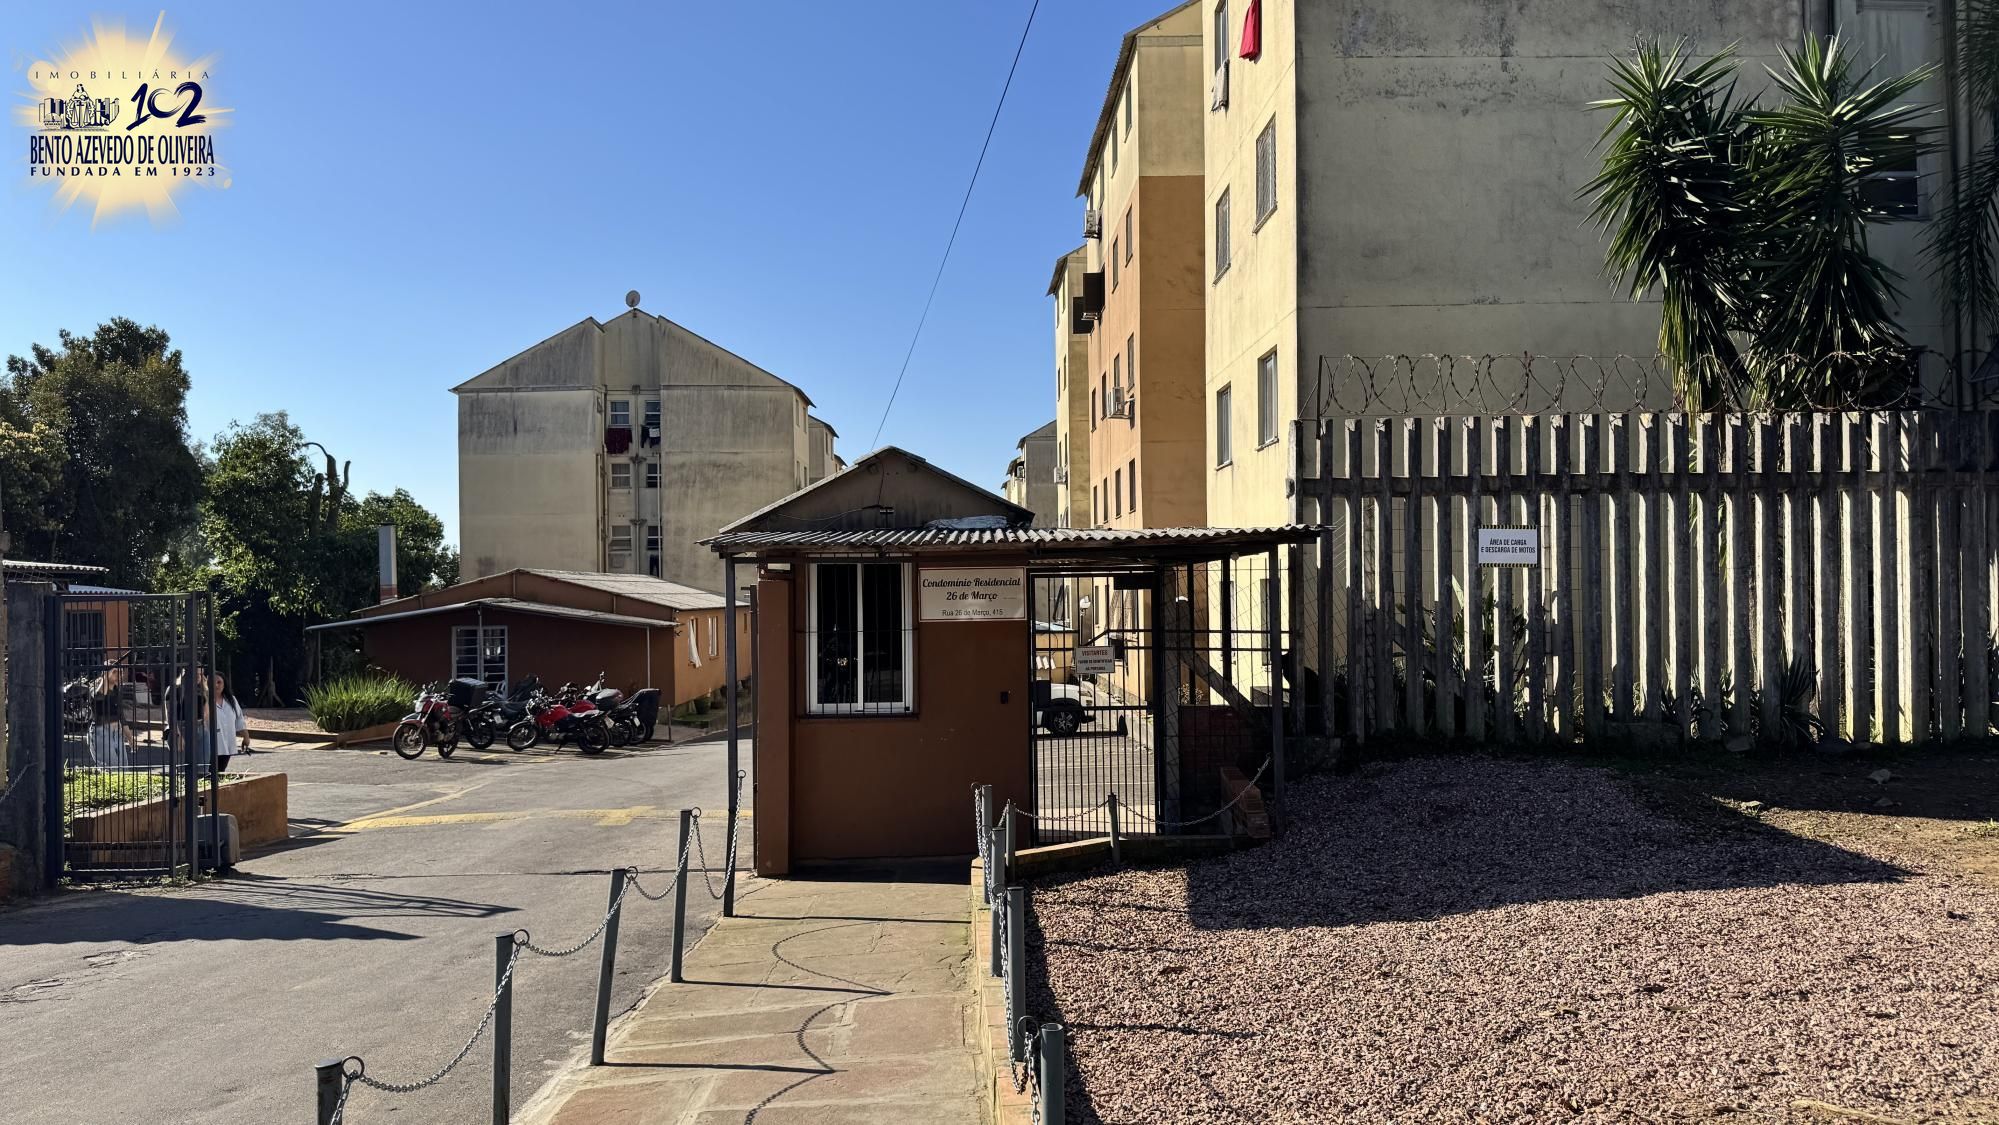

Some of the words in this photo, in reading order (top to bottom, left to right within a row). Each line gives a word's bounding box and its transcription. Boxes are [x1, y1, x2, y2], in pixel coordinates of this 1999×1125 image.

[1489, 538, 1503, 546] ÁREA
[922, 578, 972, 588] Condomínio
[972, 577, 1021, 588] Residencial
[946, 591, 958, 601] 26
[958, 591, 969, 601] de
[970, 591, 998, 602] Março
[942, 609, 954, 617] Rua
[992, 608, 1004, 616] 415
